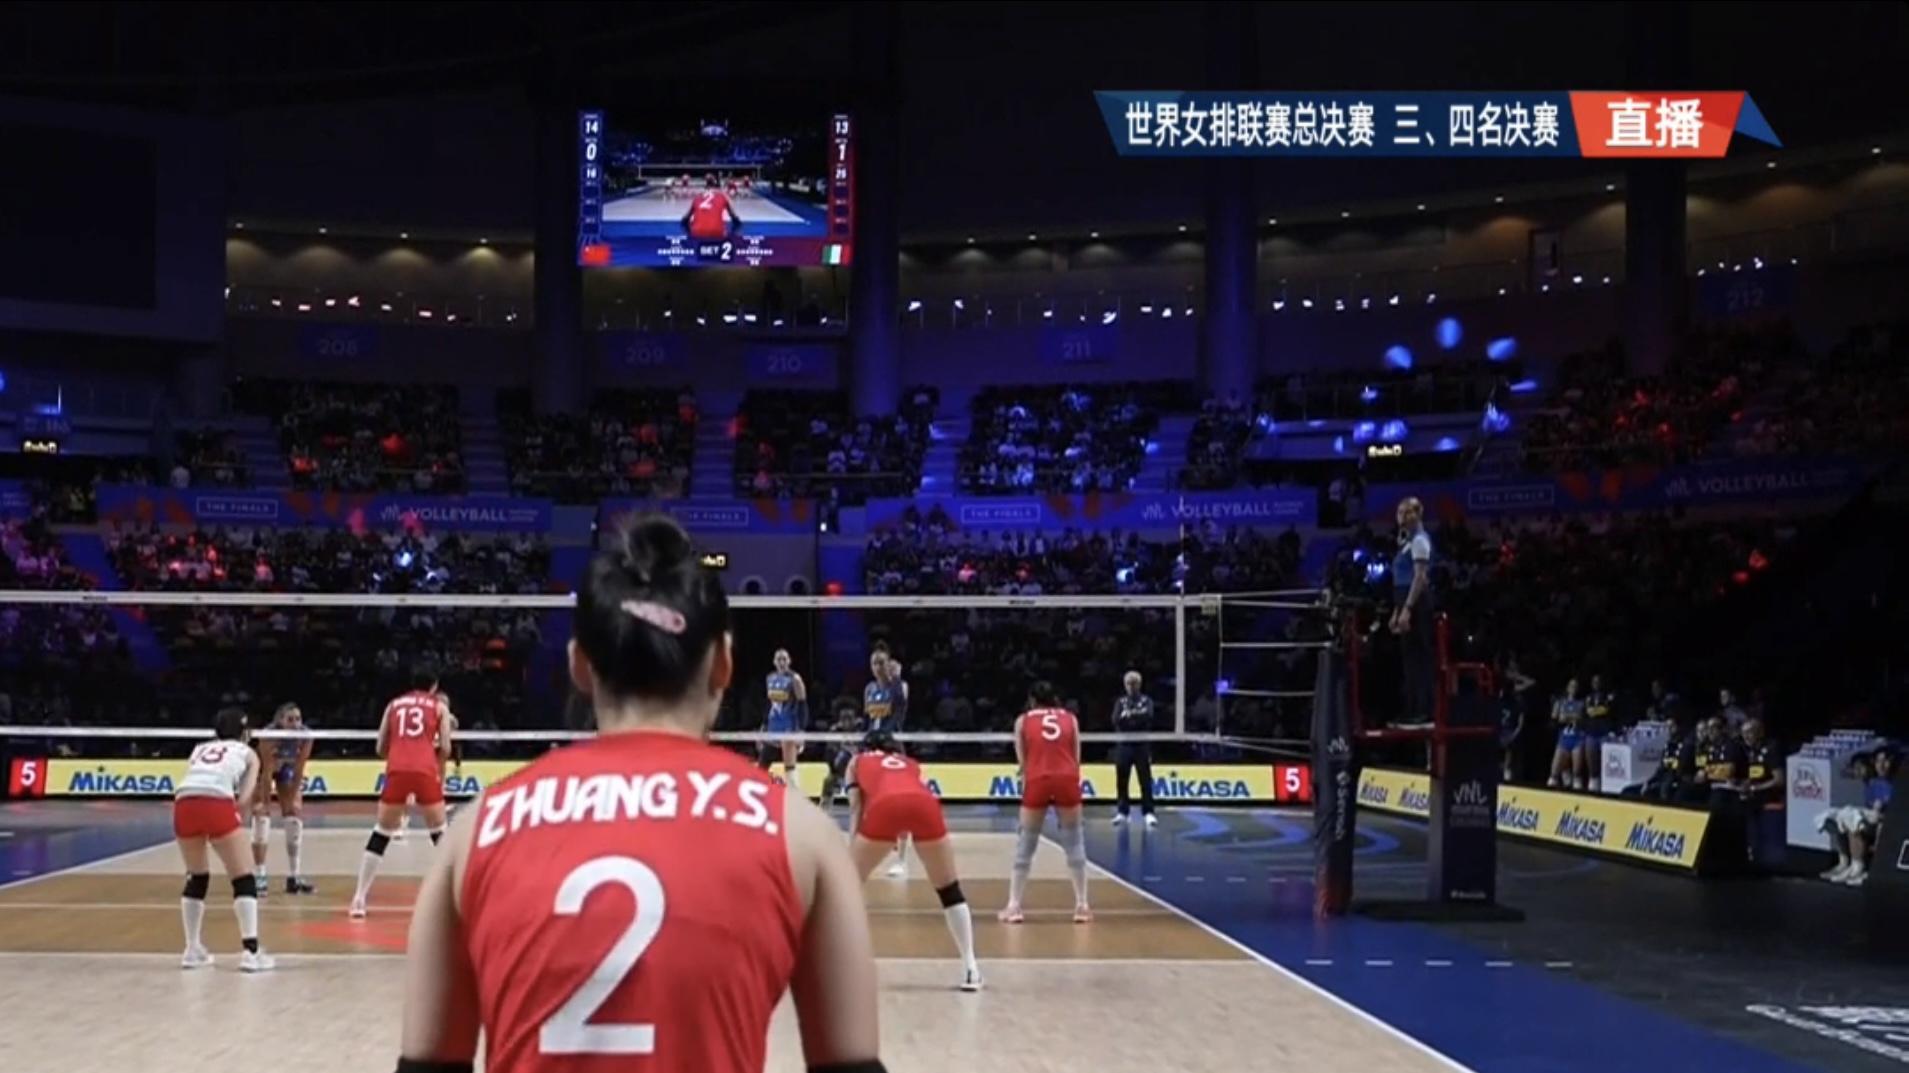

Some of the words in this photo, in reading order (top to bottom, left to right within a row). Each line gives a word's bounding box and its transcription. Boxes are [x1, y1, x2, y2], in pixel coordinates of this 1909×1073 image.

[585, 120, 599, 134] 14
[836, 121, 849, 134] 13
[586, 143, 597, 161] 0
[838, 143, 847, 161] 1
[699, 190, 716, 209] 2
[700, 245, 719, 256] SET
[721, 241, 732, 260] 2
[409, 506, 508, 522] VOLLEYBALL
[1171, 501, 1271, 519] VOLLEYBALL
[396, 706, 425, 738] 13
[1041, 714, 1061, 741] 5
[20, 761, 37, 786] 5
[1285, 767, 1300, 792] 5
[477, 772, 679, 848] ZHUANG
[686, 770, 780, 836] Y.S.
[538, 854, 666, 1055] 2
